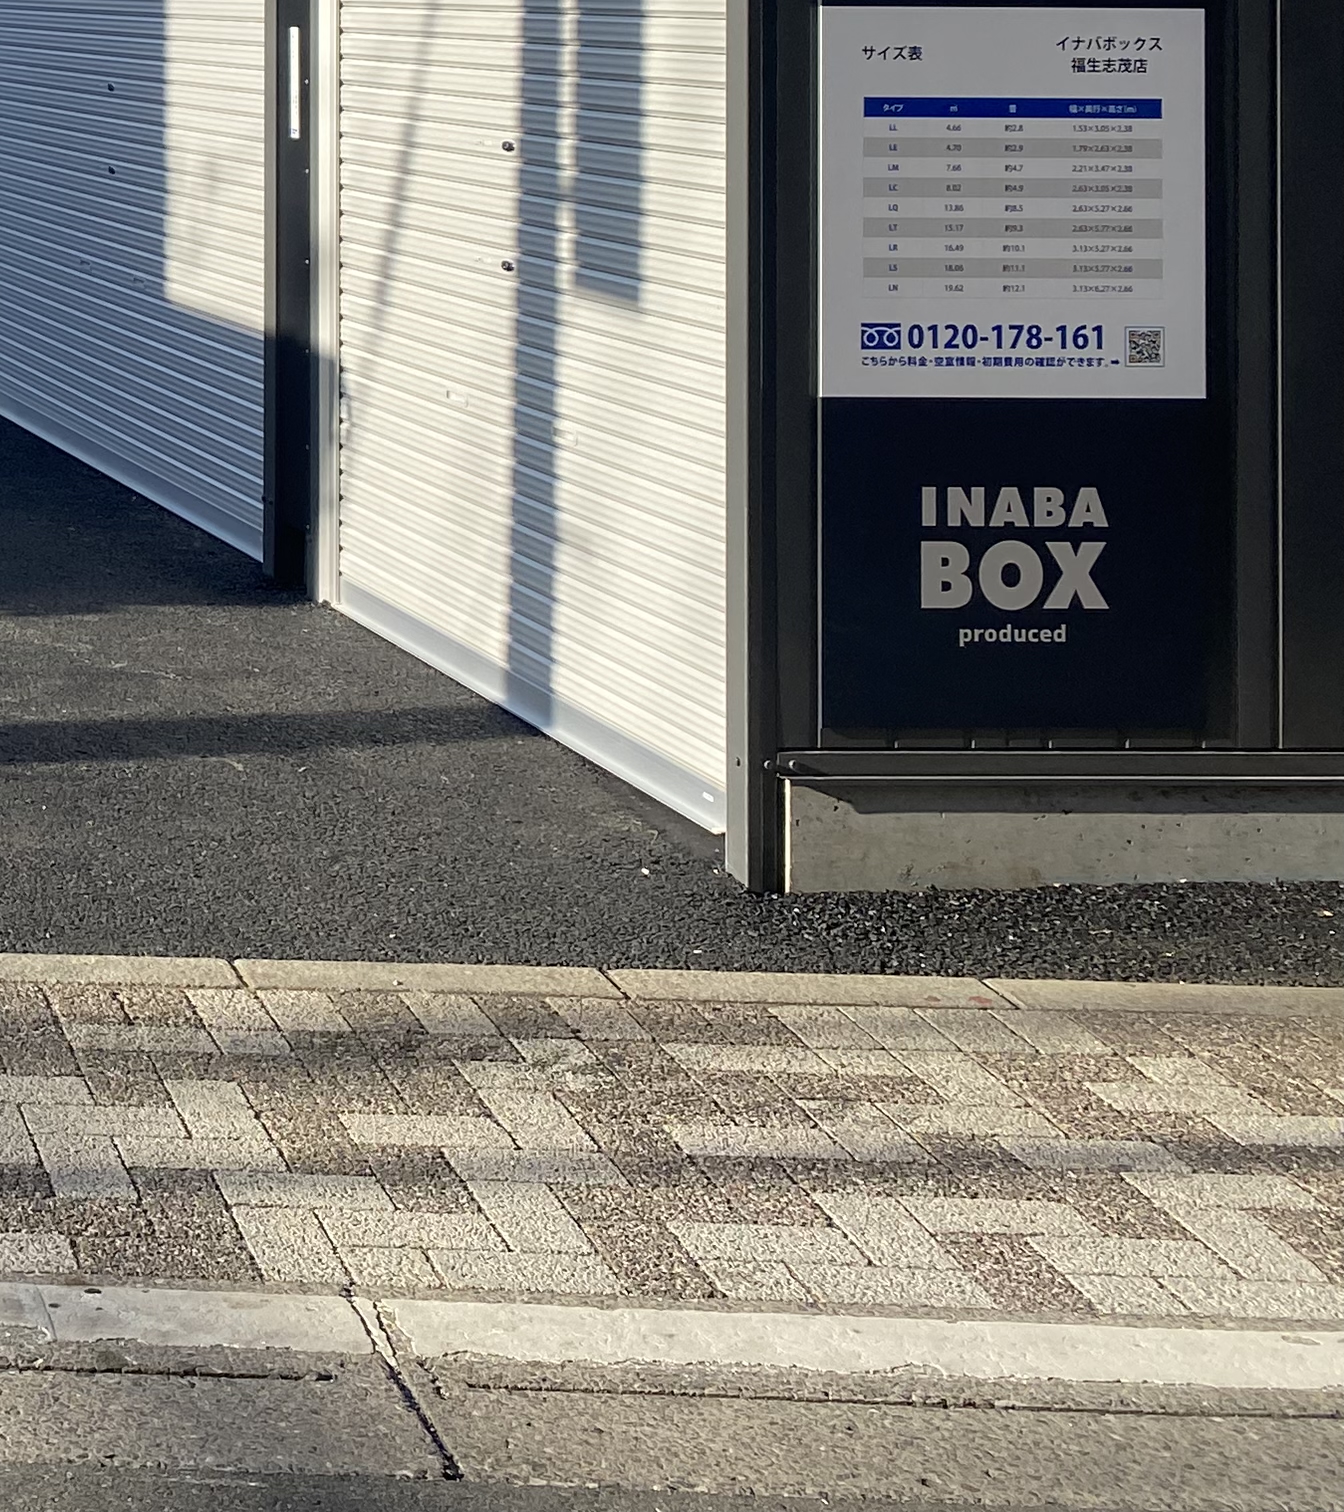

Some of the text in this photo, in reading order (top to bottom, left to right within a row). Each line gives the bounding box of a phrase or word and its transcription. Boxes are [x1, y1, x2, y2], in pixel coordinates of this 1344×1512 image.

[862, 45, 923, 61] サイズ表
[1056, 37, 1163, 52] イナバボックス
[1071, 57, 1148, 74] 福生志茂店
[908, 324, 1104, 350] 0120-178-161
[921, 487, 1109, 527] INABA
[920, 540, 1110, 611] BOX
[959, 624, 1067, 647] produced
